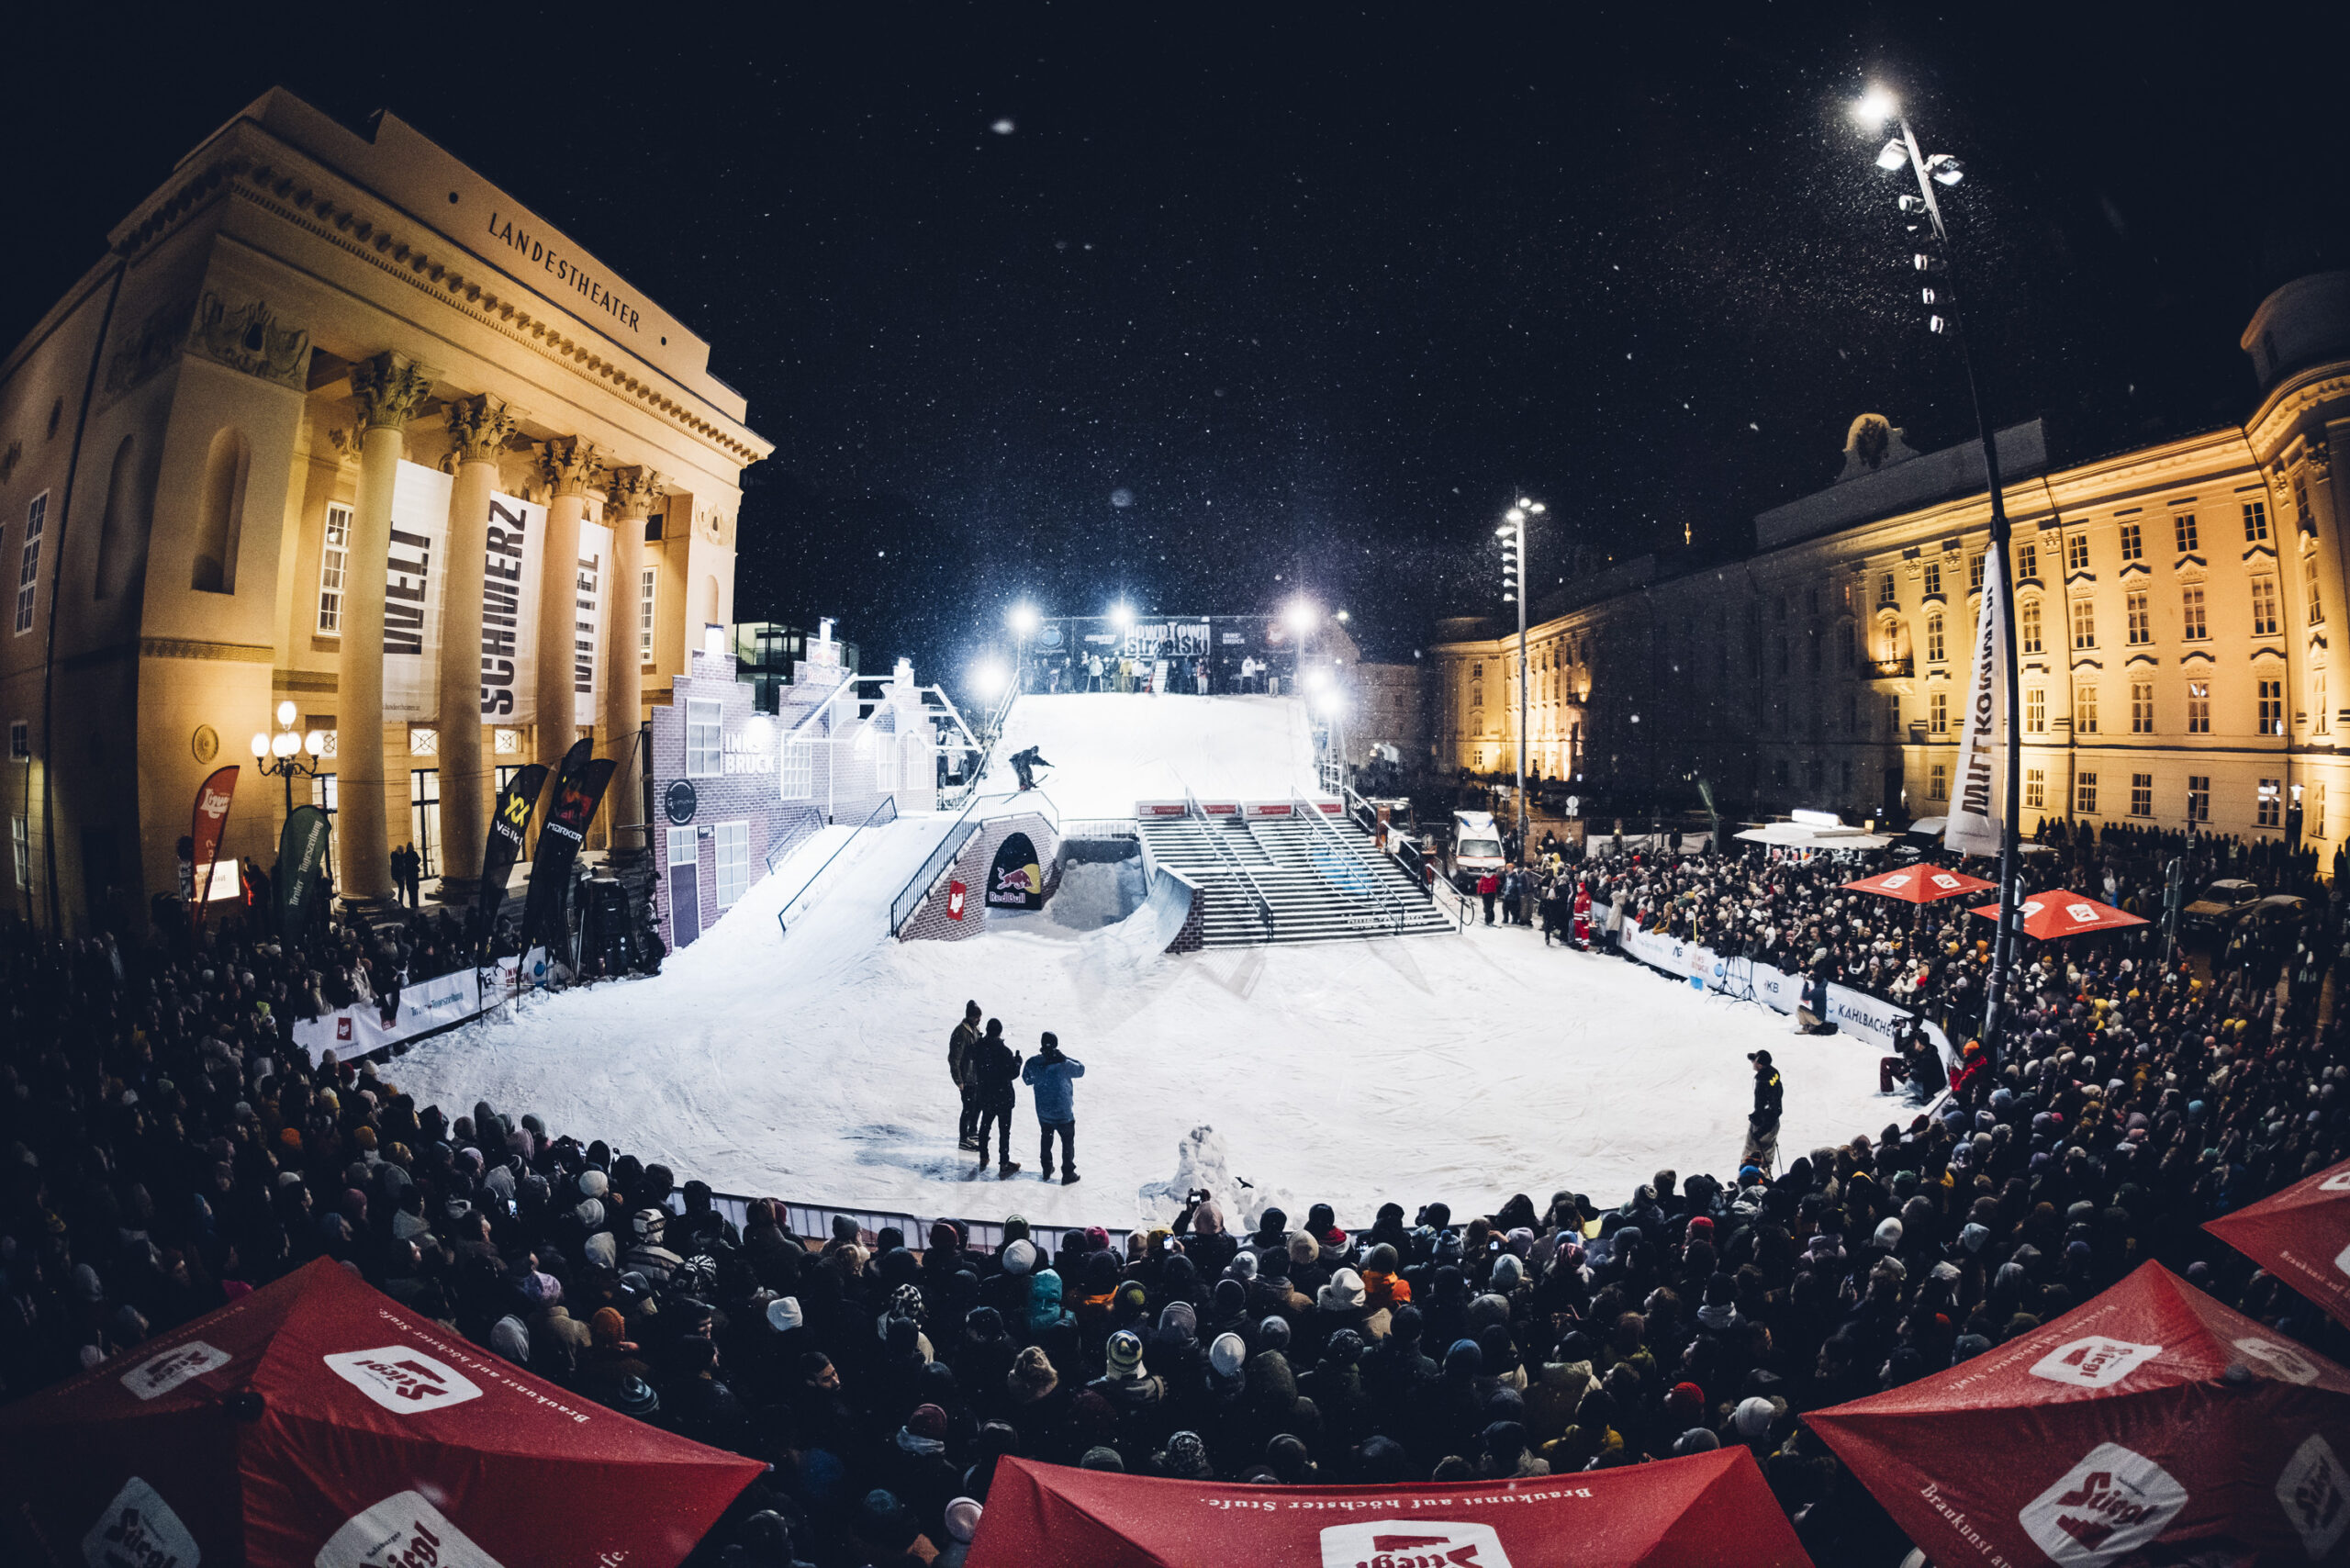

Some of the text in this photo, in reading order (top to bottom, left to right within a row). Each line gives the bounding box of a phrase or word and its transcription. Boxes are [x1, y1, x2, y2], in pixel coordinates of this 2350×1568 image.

[488, 212, 640, 333] LANDESTHEATER
[382, 521, 431, 655] WELT
[725, 754, 777, 774] BRUCK
[496, 820, 523, 846] Völkl
[288, 879, 305, 906] Tiroler
[413, 1329, 471, 1364] höchster
[352, 1360, 449, 1401] Stiegl
[468, 1363, 501, 1378] auf
[501, 1378, 591, 1424] Braukunst
[1200, 1486, 1594, 1512] Braukunst auf höchster Stufe.
[2055, 1471, 2159, 1527] Stiegl
[1919, 1483, 1993, 1555] Braukunst
